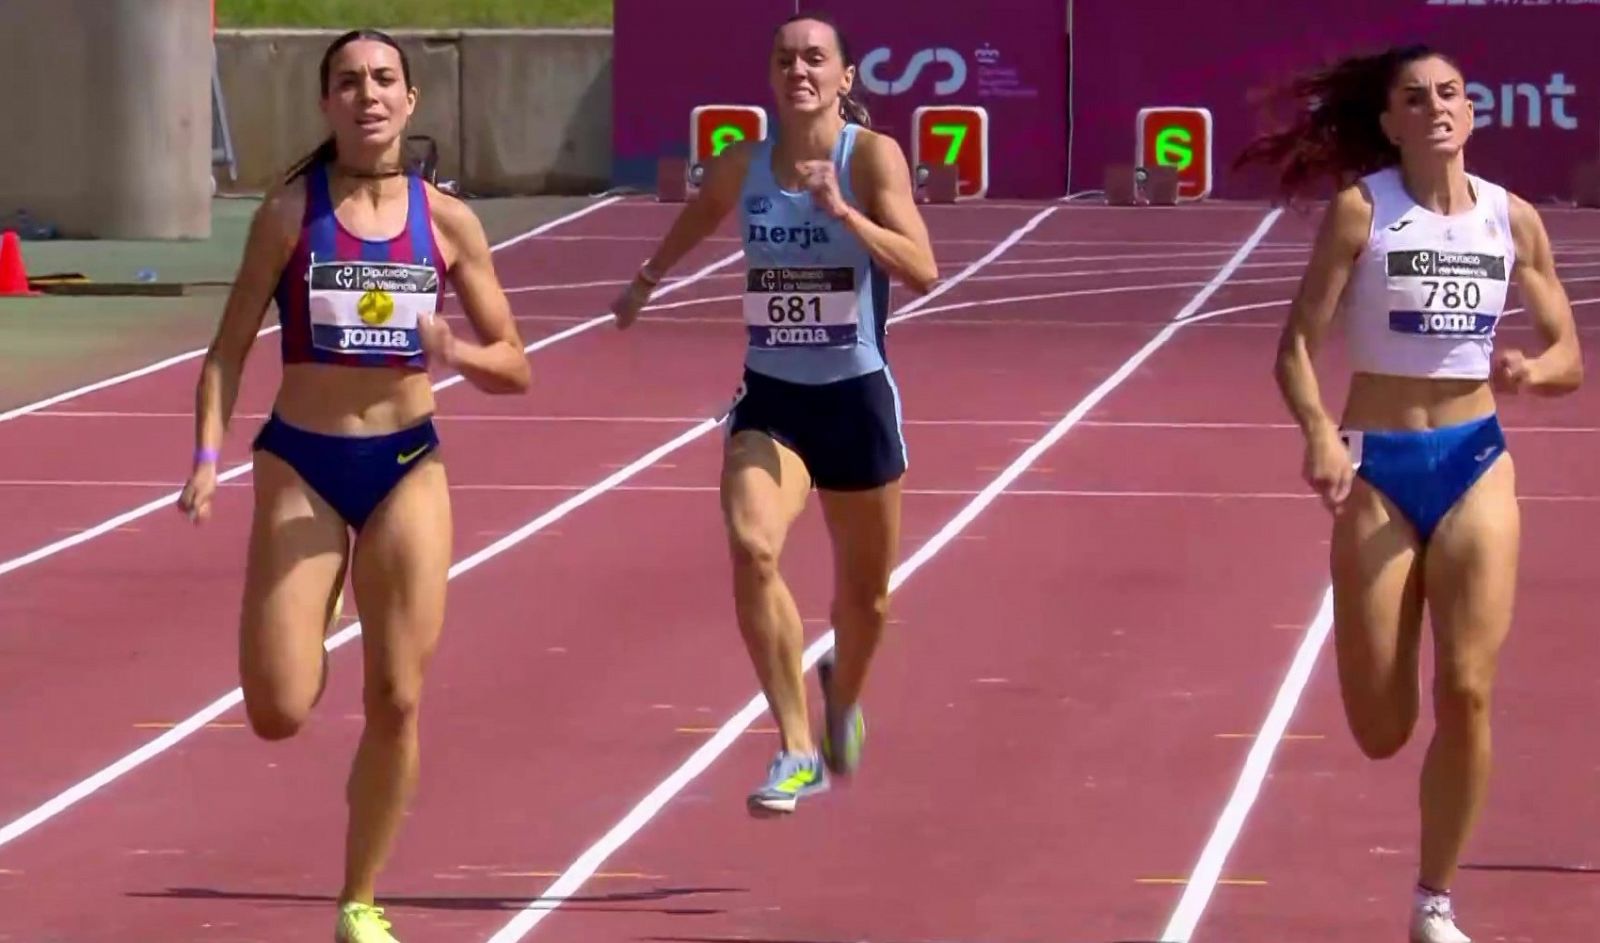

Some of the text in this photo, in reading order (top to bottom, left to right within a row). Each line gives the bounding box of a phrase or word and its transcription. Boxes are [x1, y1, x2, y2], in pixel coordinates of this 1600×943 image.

[931, 124, 968, 165] 7
[1156, 125, 1193, 171] 6
[748, 221, 830, 249] nerja
[767, 295, 821, 323] 681
[1421, 281, 1481, 309] 780
